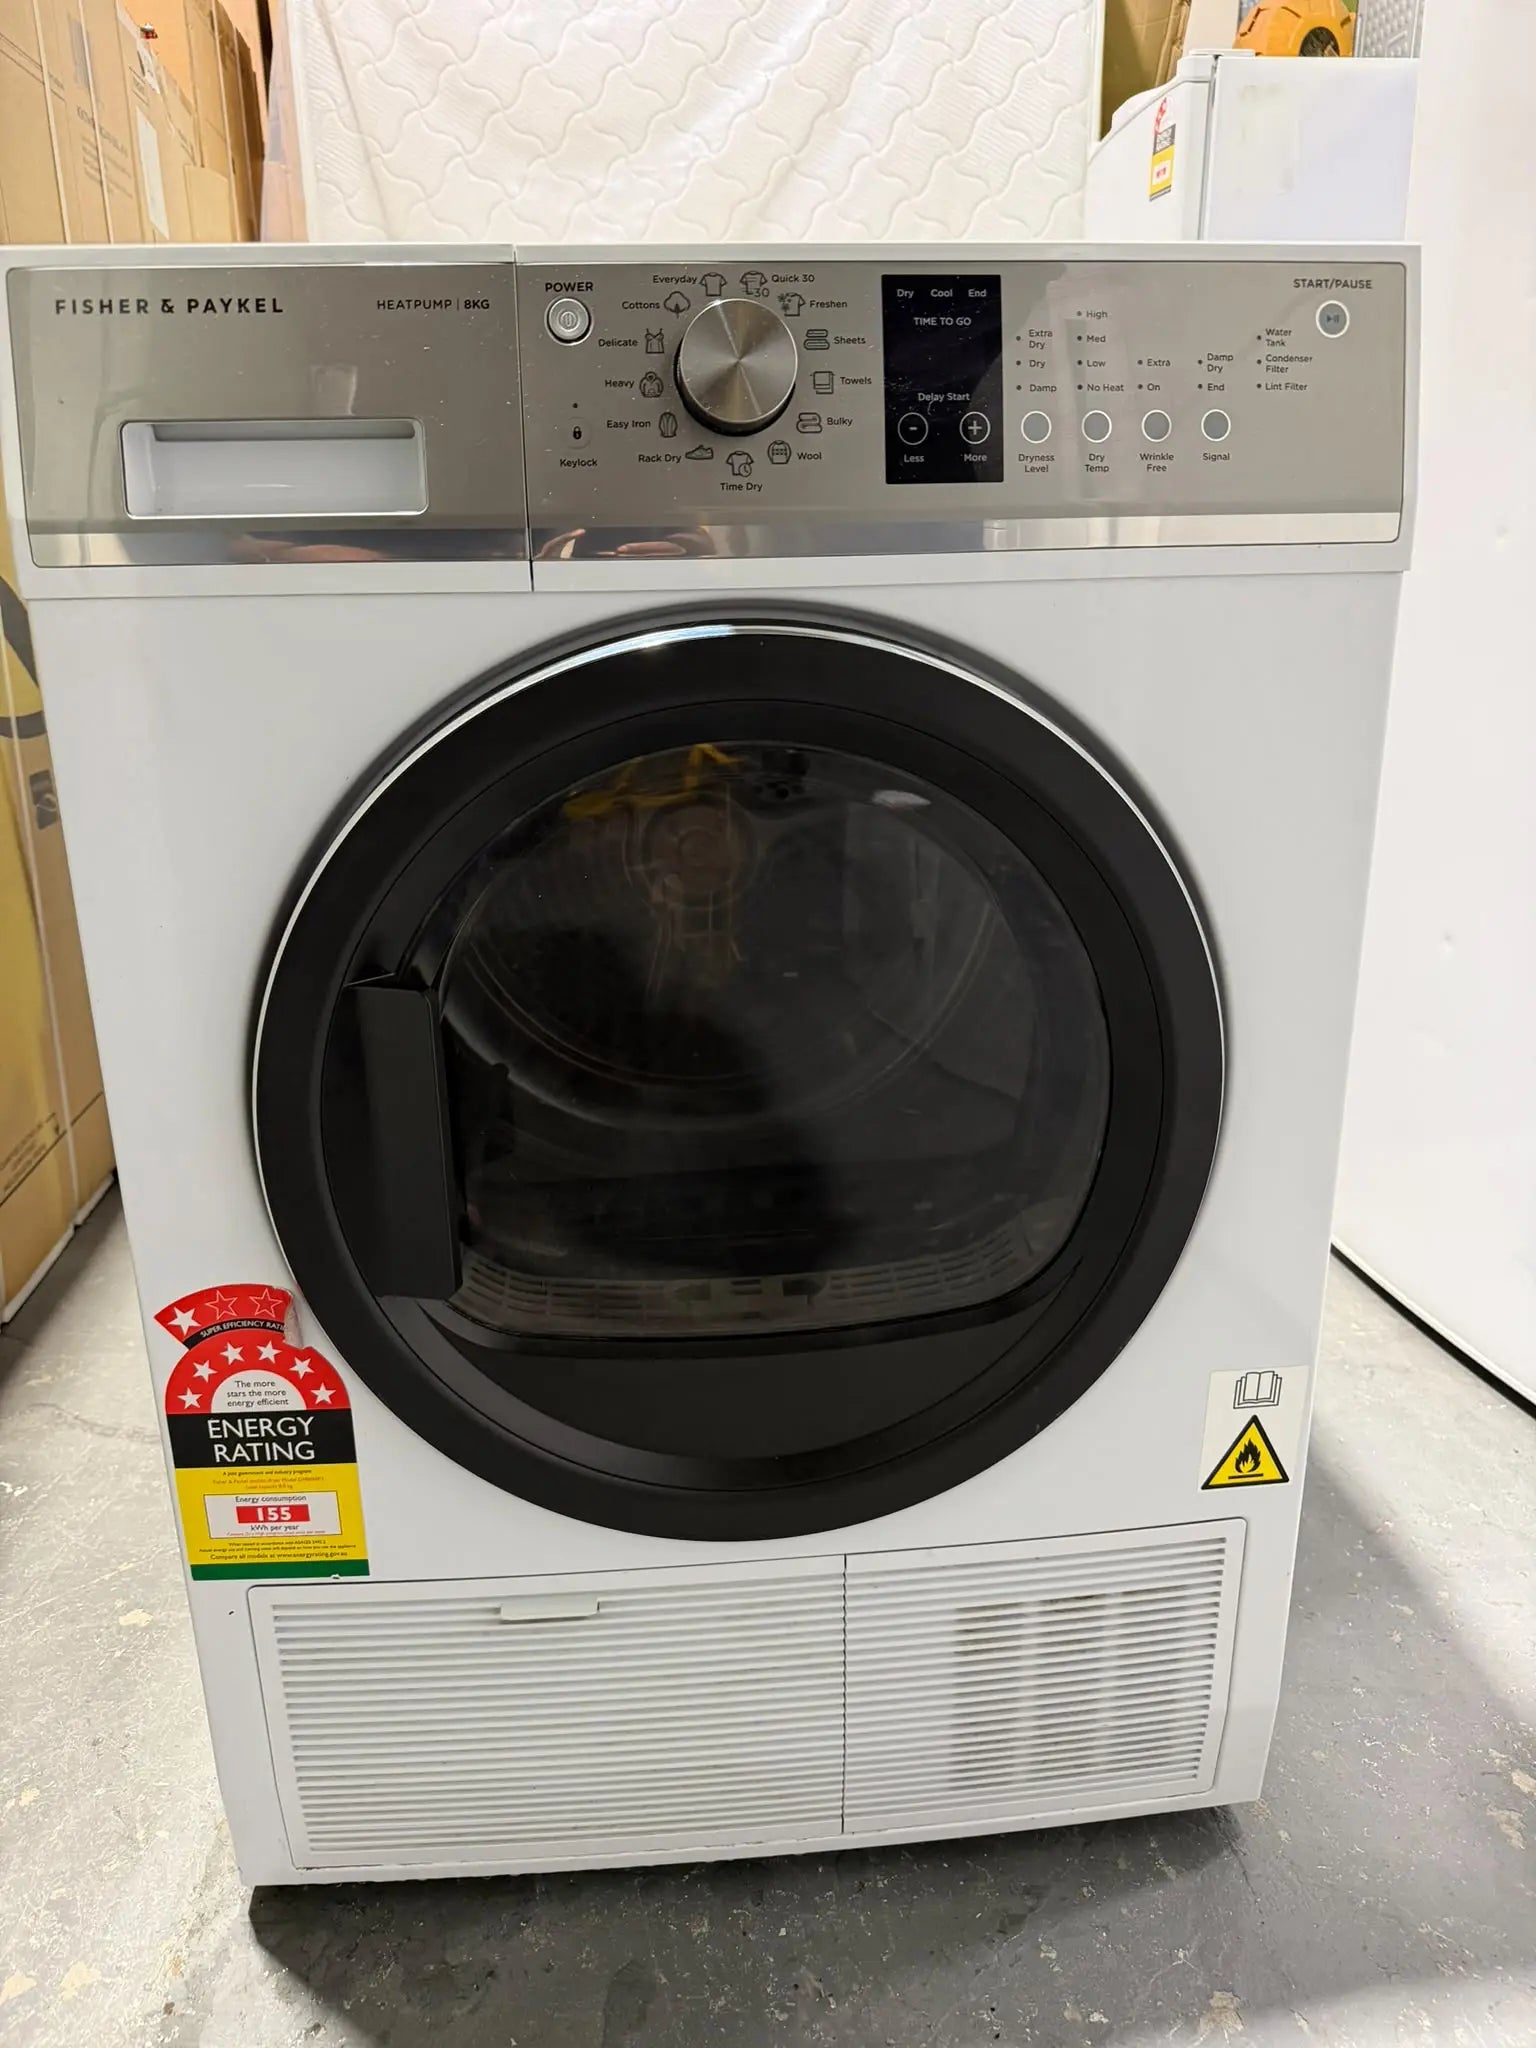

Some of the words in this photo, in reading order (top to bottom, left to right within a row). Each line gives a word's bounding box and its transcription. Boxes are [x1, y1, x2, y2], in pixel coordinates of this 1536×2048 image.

[652, 274, 697, 285] Everyday
[771, 273, 799, 284] Quick
[801, 273, 815, 283] 30
[544, 281, 594, 292] POWER
[1292, 278, 1373, 290] START/PAUSE
[754, 287, 769, 298] 30
[896, 289, 914, 299] Dry
[930, 289, 953, 298] Cool
[968, 289, 987, 298] End
[53, 297, 150, 316] FISHER
[160, 298, 175, 315] &
[186, 296, 284, 315] PAYKEL
[376, 299, 452, 311] HEATPUMP
[463, 299, 491, 311] 8KG
[622, 300, 660, 311] Cottons
[809, 299, 848, 309] Freshen
[1086, 309, 1109, 320] High
[913, 317, 937, 326] TIME
[939, 317, 952, 326] TO
[955, 317, 972, 326] GO
[1028, 329, 1053, 339] Extra
[1264, 328, 1292, 337] Water
[598, 338, 639, 348] Delicate
[833, 335, 866, 345] Sheets
[1086, 334, 1106, 343] Med
[1264, 338, 1286, 348] Tank
[1028, 340, 1046, 351] Dry
[1146, 358, 1171, 367] Extra
[1206, 353, 1234, 363] Damp
[1264, 354, 1313, 363] Condenser
[1029, 359, 1047, 369] Dry
[1086, 359, 1107, 368] Low
[1206, 363, 1224, 374] Dry
[1264, 364, 1289, 374] Filter
[604, 378, 635, 390] Heavy
[839, 376, 872, 385] Towels
[1029, 383, 1057, 394] Damp
[1086, 383, 1100, 392] No
[1102, 383, 1125, 392] Heat
[1146, 383, 1161, 392] On
[1206, 383, 1225, 392] End
[1264, 382, 1281, 391] Lint
[1283, 382, 1308, 391] Filter
[917, 392, 944, 403] Delay
[946, 392, 970, 402] Start
[606, 420, 629, 430] Easy
[632, 419, 651, 428] Iron
[826, 416, 853, 428] Bulky
[638, 453, 660, 463] Rack
[662, 453, 682, 464] Dry
[796, 451, 822, 461] Wool
[903, 454, 925, 463] Less
[963, 453, 988, 463] More
[1017, 453, 1055, 464] Dryness
[1088, 452, 1106, 464] Dry
[1139, 452, 1175, 462] Wrinkle
[1202, 452, 1231, 463] Signal
[559, 458, 598, 469] Keylock
[1024, 464, 1049, 473] Level
[1146, 464, 1168, 473] Free
[1084, 464, 1110, 474] Temp
[720, 482, 742, 491] Time
[743, 482, 763, 493] Dry
[200, 1326, 222, 1337] SUPER
[222, 1320, 264, 1330] EFFICIENCY
[235, 1380, 251, 1388] The
[227, 1390, 247, 1398] stars
[248, 1389, 262, 1397] the
[227, 1399, 255, 1408] energy
[257, 1398, 288, 1406] efficient
[208, 1416, 314, 1439] ENERGY
[214, 1441, 315, 1462] RATING
[256, 1507, 292, 1522] 155
